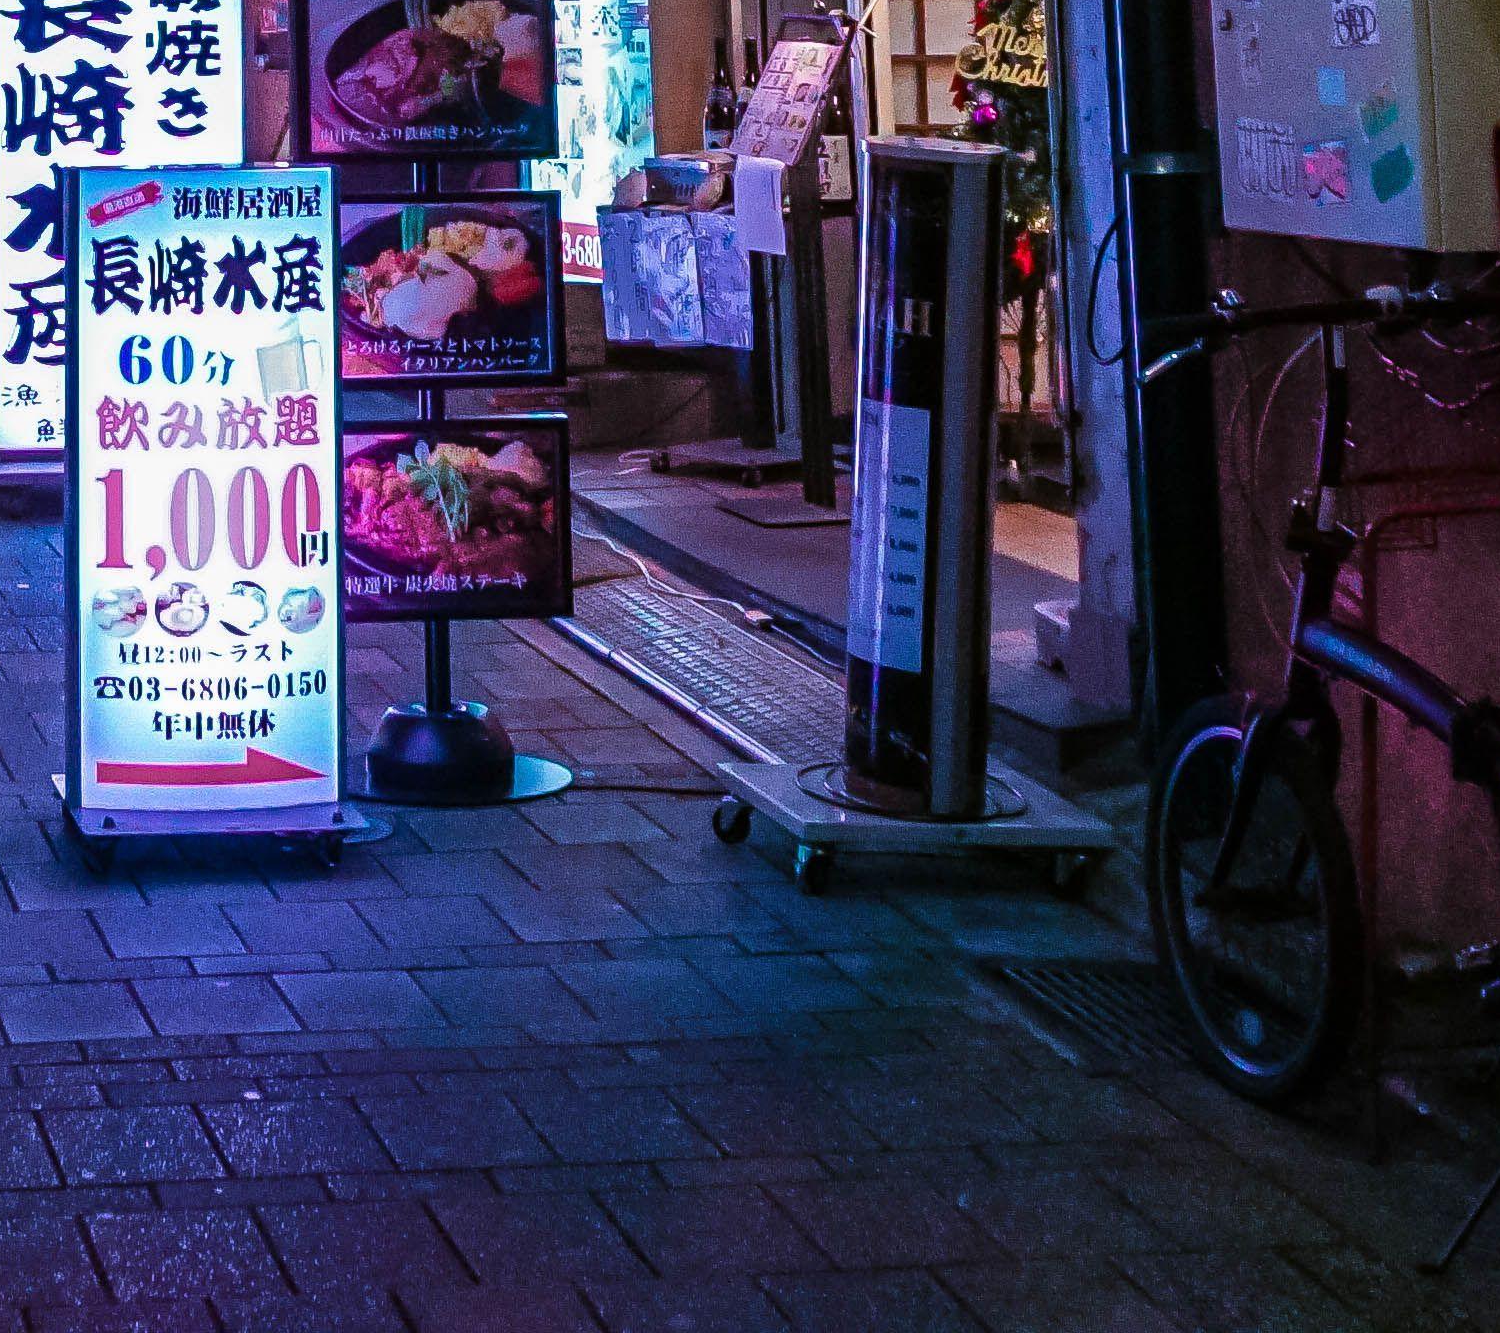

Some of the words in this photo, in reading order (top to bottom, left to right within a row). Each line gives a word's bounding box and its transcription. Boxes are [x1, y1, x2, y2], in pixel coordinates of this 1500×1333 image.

[172, 184, 323, 221] 海鮮居酒屋
[85, 233, 326, 316] 長崎水産
[119, 332, 236, 388] 60分
[96, 394, 322, 451] 飲み放題
[95, 463, 330, 582] 1,000円
[128, 669, 327, 704] 03-6806-0150
[153, 710, 276, 742] 年中無休
